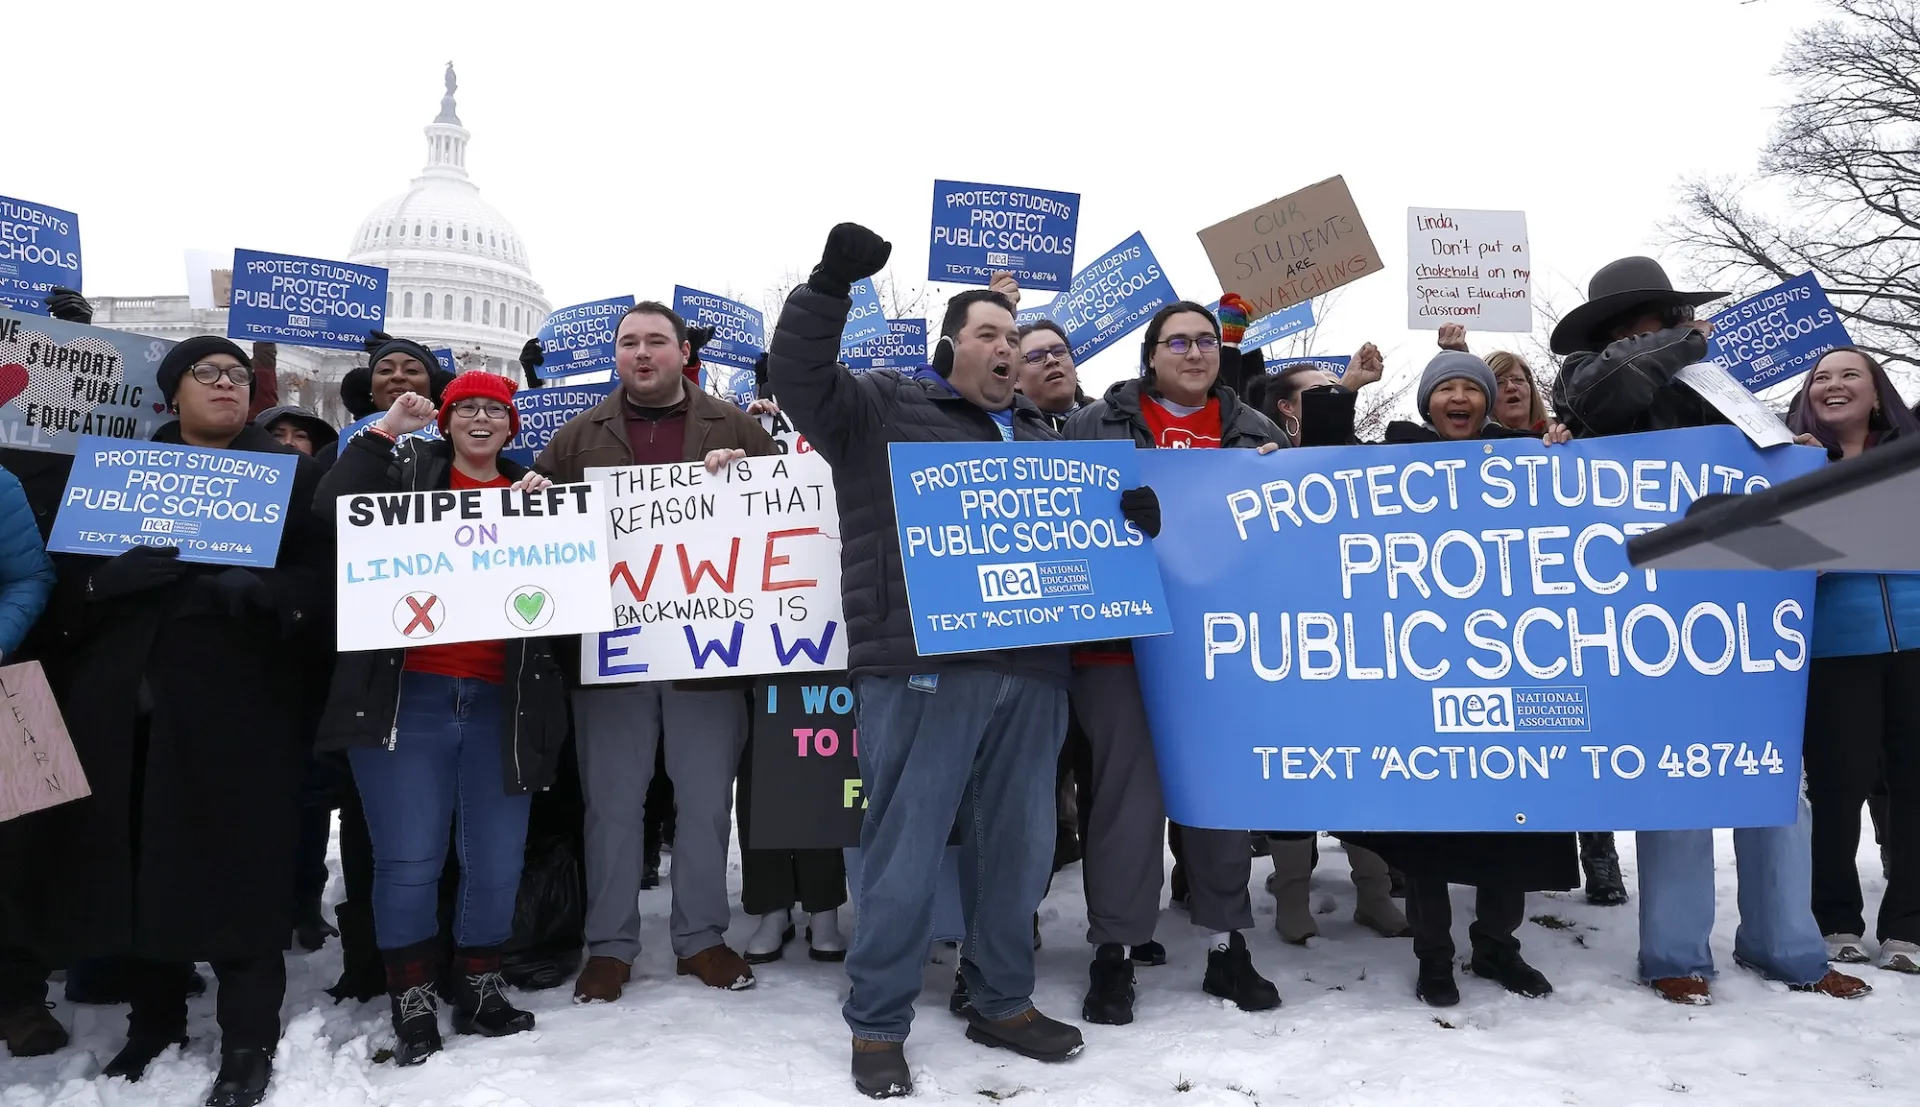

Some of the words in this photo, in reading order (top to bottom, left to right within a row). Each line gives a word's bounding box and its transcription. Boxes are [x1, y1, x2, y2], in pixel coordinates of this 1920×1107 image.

[0, 201, 69, 236] TUDENTS
[946, 191, 1008, 208] PROTECT
[1009, 192, 1071, 220] STUDENTS
[1254, 202, 1306, 235] OUR
[970, 208, 1046, 232] PROTECT
[1416, 213, 1459, 231] Linda,
[934, 226, 995, 249] PUBLIC
[998, 231, 1073, 255] SCHOOLS
[1234, 215, 1354, 280] STUDENTS
[1431, 238, 1472, 255] Don't
[1478, 240, 1503, 259] put
[1512, 244, 1522, 252] a
[0, 240, 78, 271] CHOOLS
[988, 253, 1007, 265] nea
[1286, 257, 1316, 279] ARE
[12, 280, 29, 290] TO
[32, 282, 65, 292] 487
[247, 260, 309, 274] PROTECT
[311, 264, 378, 291] STUDENTS
[946, 264, 972, 275] TEXT
[973, 266, 1016, 277] "ACT"
[1018, 270, 1031, 279] TO
[1031, 271, 1057, 282] 48744
[1052, 276, 1087, 318] PROTECT
[1086, 246, 1141, 281] STUDENTS
[1250, 254, 1368, 313] WATCHING
[1415, 263, 1480, 279] chokehold
[1488, 267, 1505, 279] on
[1513, 269, 1531, 284] my
[271, 275, 350, 300] PROTECT
[1063, 306, 1096, 337] UBLIC
[1094, 264, 1161, 313] SCHOOLS
[1067, 267, 1125, 315] PROTECT
[1416, 285, 1460, 303] Special
[1467, 286, 1526, 300] Education
[234, 289, 298, 312] PUBLIC
[300, 297, 382, 321] SCHOOLS
[540, 309, 577, 329] ROTECT
[578, 304, 629, 317] STUDENTS
[682, 295, 721, 309] PROTECT
[721, 301, 760, 327] STUDENTS
[697, 307, 746, 330] PROTECT
[847, 302, 878, 322] OOLS
[1419, 303, 1481, 318] classroom!
[1707, 310, 1741, 340] TECT
[1741, 286, 1811, 319] STUDENTS
[246, 323, 273, 334] TEXT
[275, 327, 319, 338] "ACTION"
[321, 331, 335, 341] TO
[337, 332, 366, 344] 48744
[290, 315, 309, 326] nea
[553, 316, 610, 338] PROTECT
[887, 323, 921, 335] TUDENTS
[1072, 341, 1092, 358] TEXT
[1125, 312, 1139, 324] TO
[1138, 298, 1163, 317] 48744
[1096, 314, 1113, 330] nea
[1715, 307, 1790, 352] PROTECT
[537, 336, 576, 353] UBLIC
[578, 328, 615, 348] SCHO
[715, 325, 764, 349] SCHOOLS
[840, 346, 876, 358] PUBLIC
[877, 344, 925, 357] SCHOOLS
[861, 333, 905, 345] OTECT
[1239, 333, 1267, 348] ACTION"
[1711, 344, 1754, 371] BLIC
[1751, 308, 1834, 355] SCHOOLS
[26, 341, 118, 378] SUPPORT
[545, 364, 564, 373] TEXT
[599, 356, 610, 364] TO
[698, 347, 727, 358] ACTION"
[728, 353, 737, 361] TO
[1751, 356, 1772, 371] nea
[1787, 355, 1804, 367] TO
[1804, 343, 1835, 361] 48744
[72, 376, 142, 408] PUBLIC
[512, 394, 540, 410] TECT
[26, 403, 137, 439] EDUCATION
[519, 407, 583, 431] ROTECT
[94, 450, 185, 468] PROTECT
[186, 452, 281, 485] STUDENTS
[609, 464, 706, 497] THERE
[726, 461, 753, 484] IS
[772, 459, 789, 479] A
[910, 457, 1008, 496] PROTECT
[1013, 456, 1121, 491] STUDENTS
[125, 470, 239, 498] PROTECT
[66, 486, 160, 514] PUBLIC
[161, 494, 281, 524] SCHOOLS
[348, 490, 483, 527] SWIPE
[500, 485, 592, 517] LEFT
[610, 494, 716, 540] REASON
[740, 485, 824, 517] THAT
[960, 486, 1083, 520] PROTECT
[1226, 459, 1467, 541] PROTECT
[144, 519, 171, 532] nea
[454, 523, 499, 547] ON
[905, 523, 1011, 558] PUBLIC
[1014, 518, 1145, 553] SCHOOLS
[78, 531, 117, 543] TEXT
[119, 533, 184, 547] "ACTION"
[187, 539, 207, 550] TO
[210, 541, 253, 554] 48744
[347, 551, 454, 584] LINDA
[1040, 565, 1086, 575] NATIONAL
[1338, 522, 1669, 600] PROTECT
[983, 567, 1038, 597] nea
[1042, 574, 1088, 584] EDUCATION
[1044, 583, 1090, 594] ASSOCIATION
[614, 597, 754, 628] BACKWARDS
[779, 595, 808, 622] IS
[927, 613, 977, 632] TEXT
[981, 605, 1065, 628] "ACTION"
[1069, 603, 1096, 621] TO
[1099, 600, 1154, 619] 48744
[1203, 610, 1450, 682] PUBLIC
[1463, 599, 1807, 680] SCHOOLS
[767, 685, 778, 714] I
[801, 685, 855, 715] WO
[1438, 693, 1510, 727] nea
[1515, 692, 1583, 703] NATIONAL
[1517, 704, 1584, 716] EDUCATION
[0, 678, 61, 792] LEARN
[1518, 716, 1585, 727] ASSOCIATION
[792, 728, 839, 758] TO
[1252, 746, 1362, 780] TEXT
[1371, 745, 1567, 781] "ACTION"
[1580, 744, 1646, 780] TO
[1657, 740, 1784, 779] 48744
